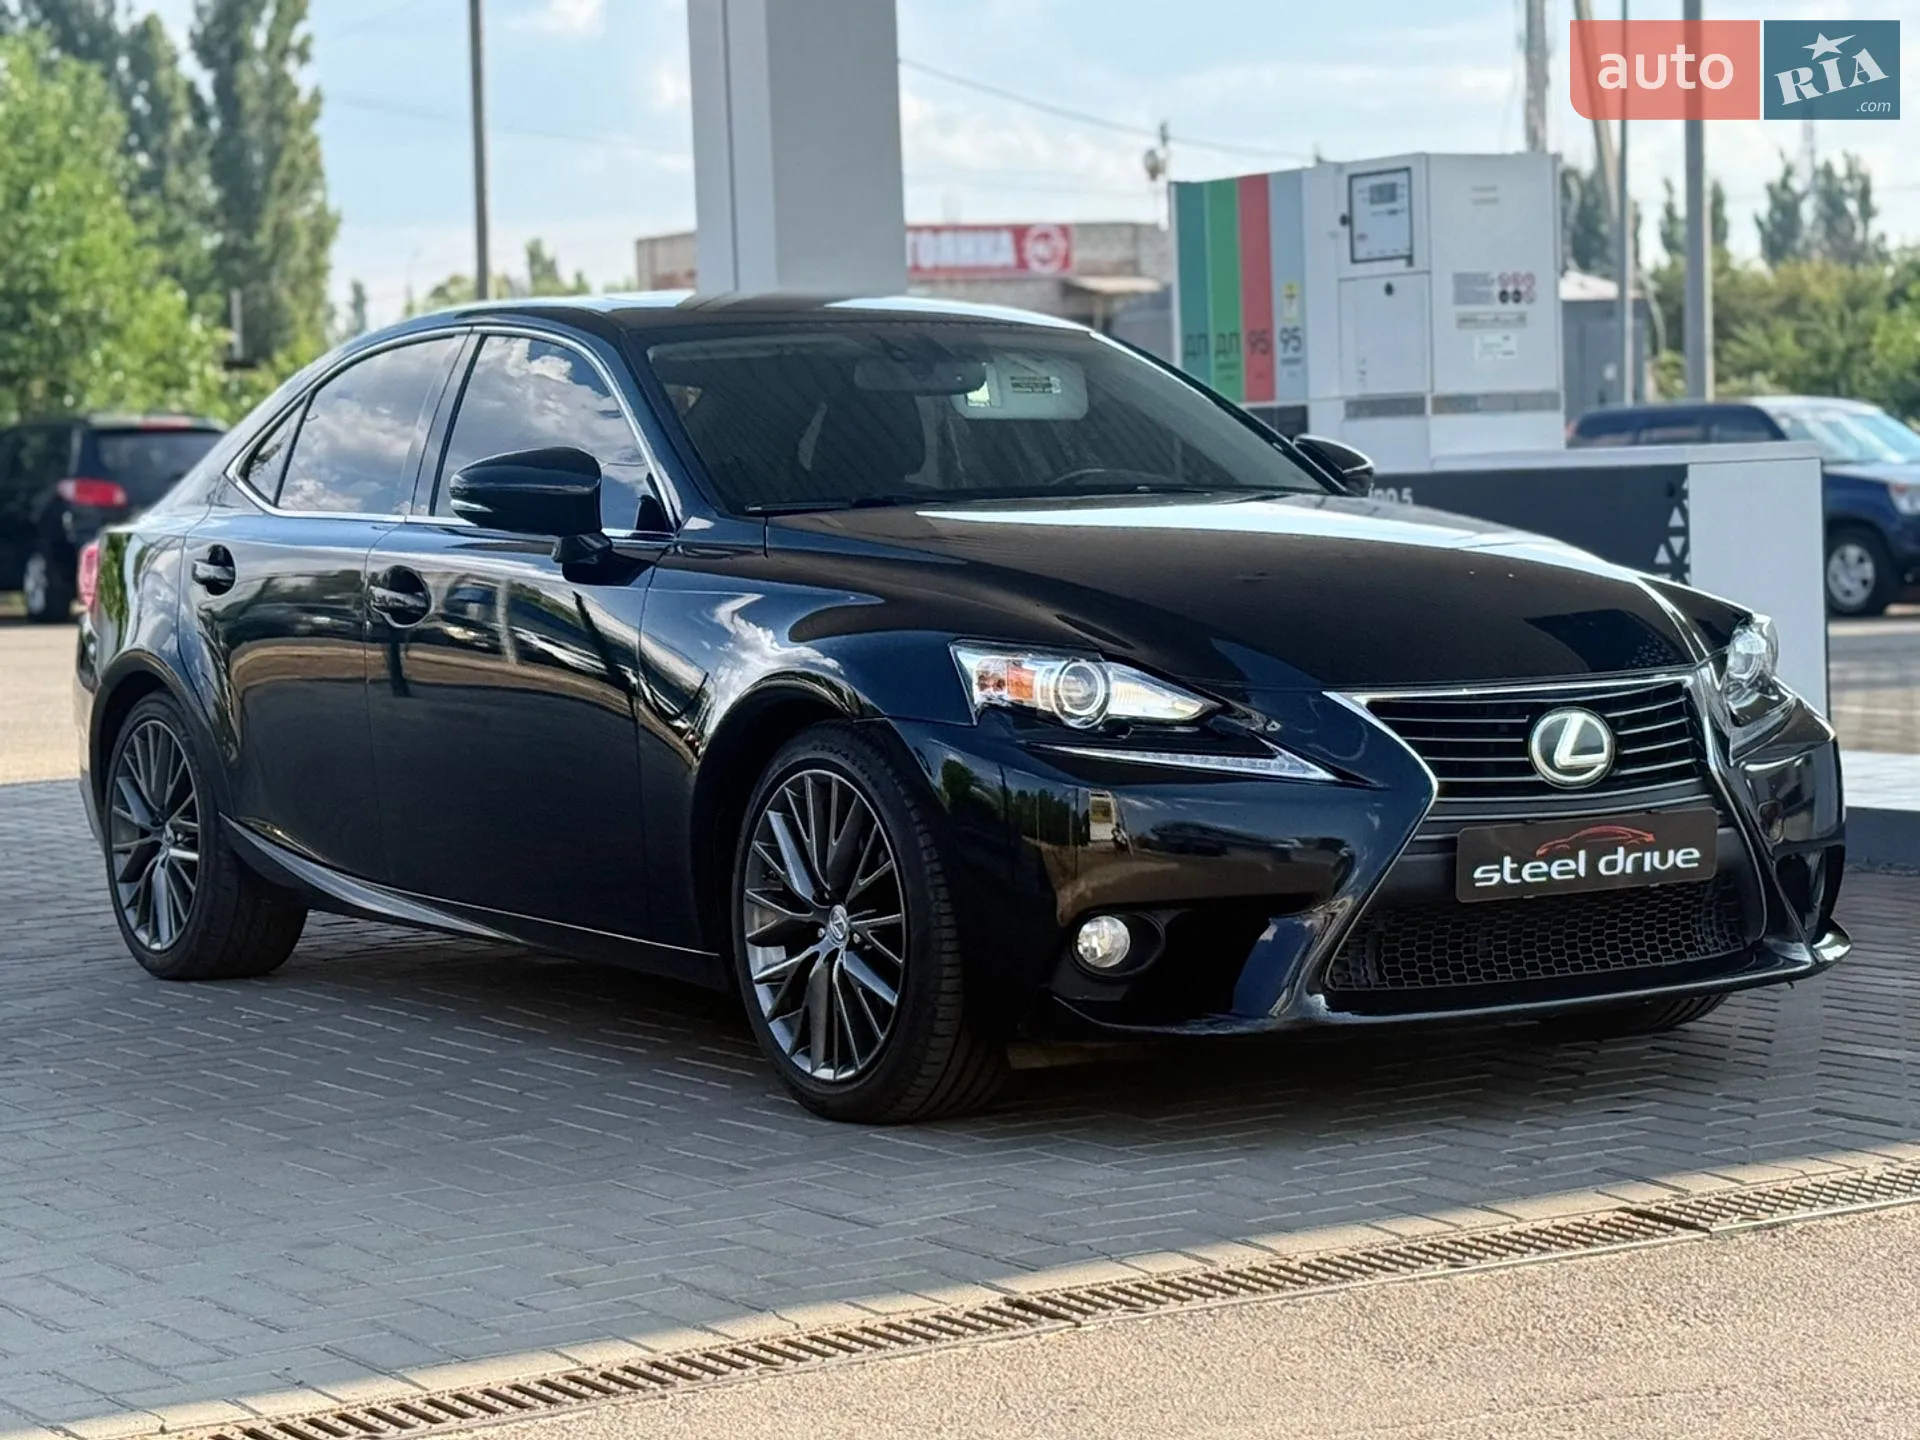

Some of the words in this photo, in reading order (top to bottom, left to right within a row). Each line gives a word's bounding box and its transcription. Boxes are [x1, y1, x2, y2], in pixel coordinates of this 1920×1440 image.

[1214, 331, 1240, 359] ДП
[1247, 329, 1270, 355] 95
[1279, 326, 1302, 353] 95
[1472, 849, 1587, 887] steel
[1597, 846, 1701, 876] drive
